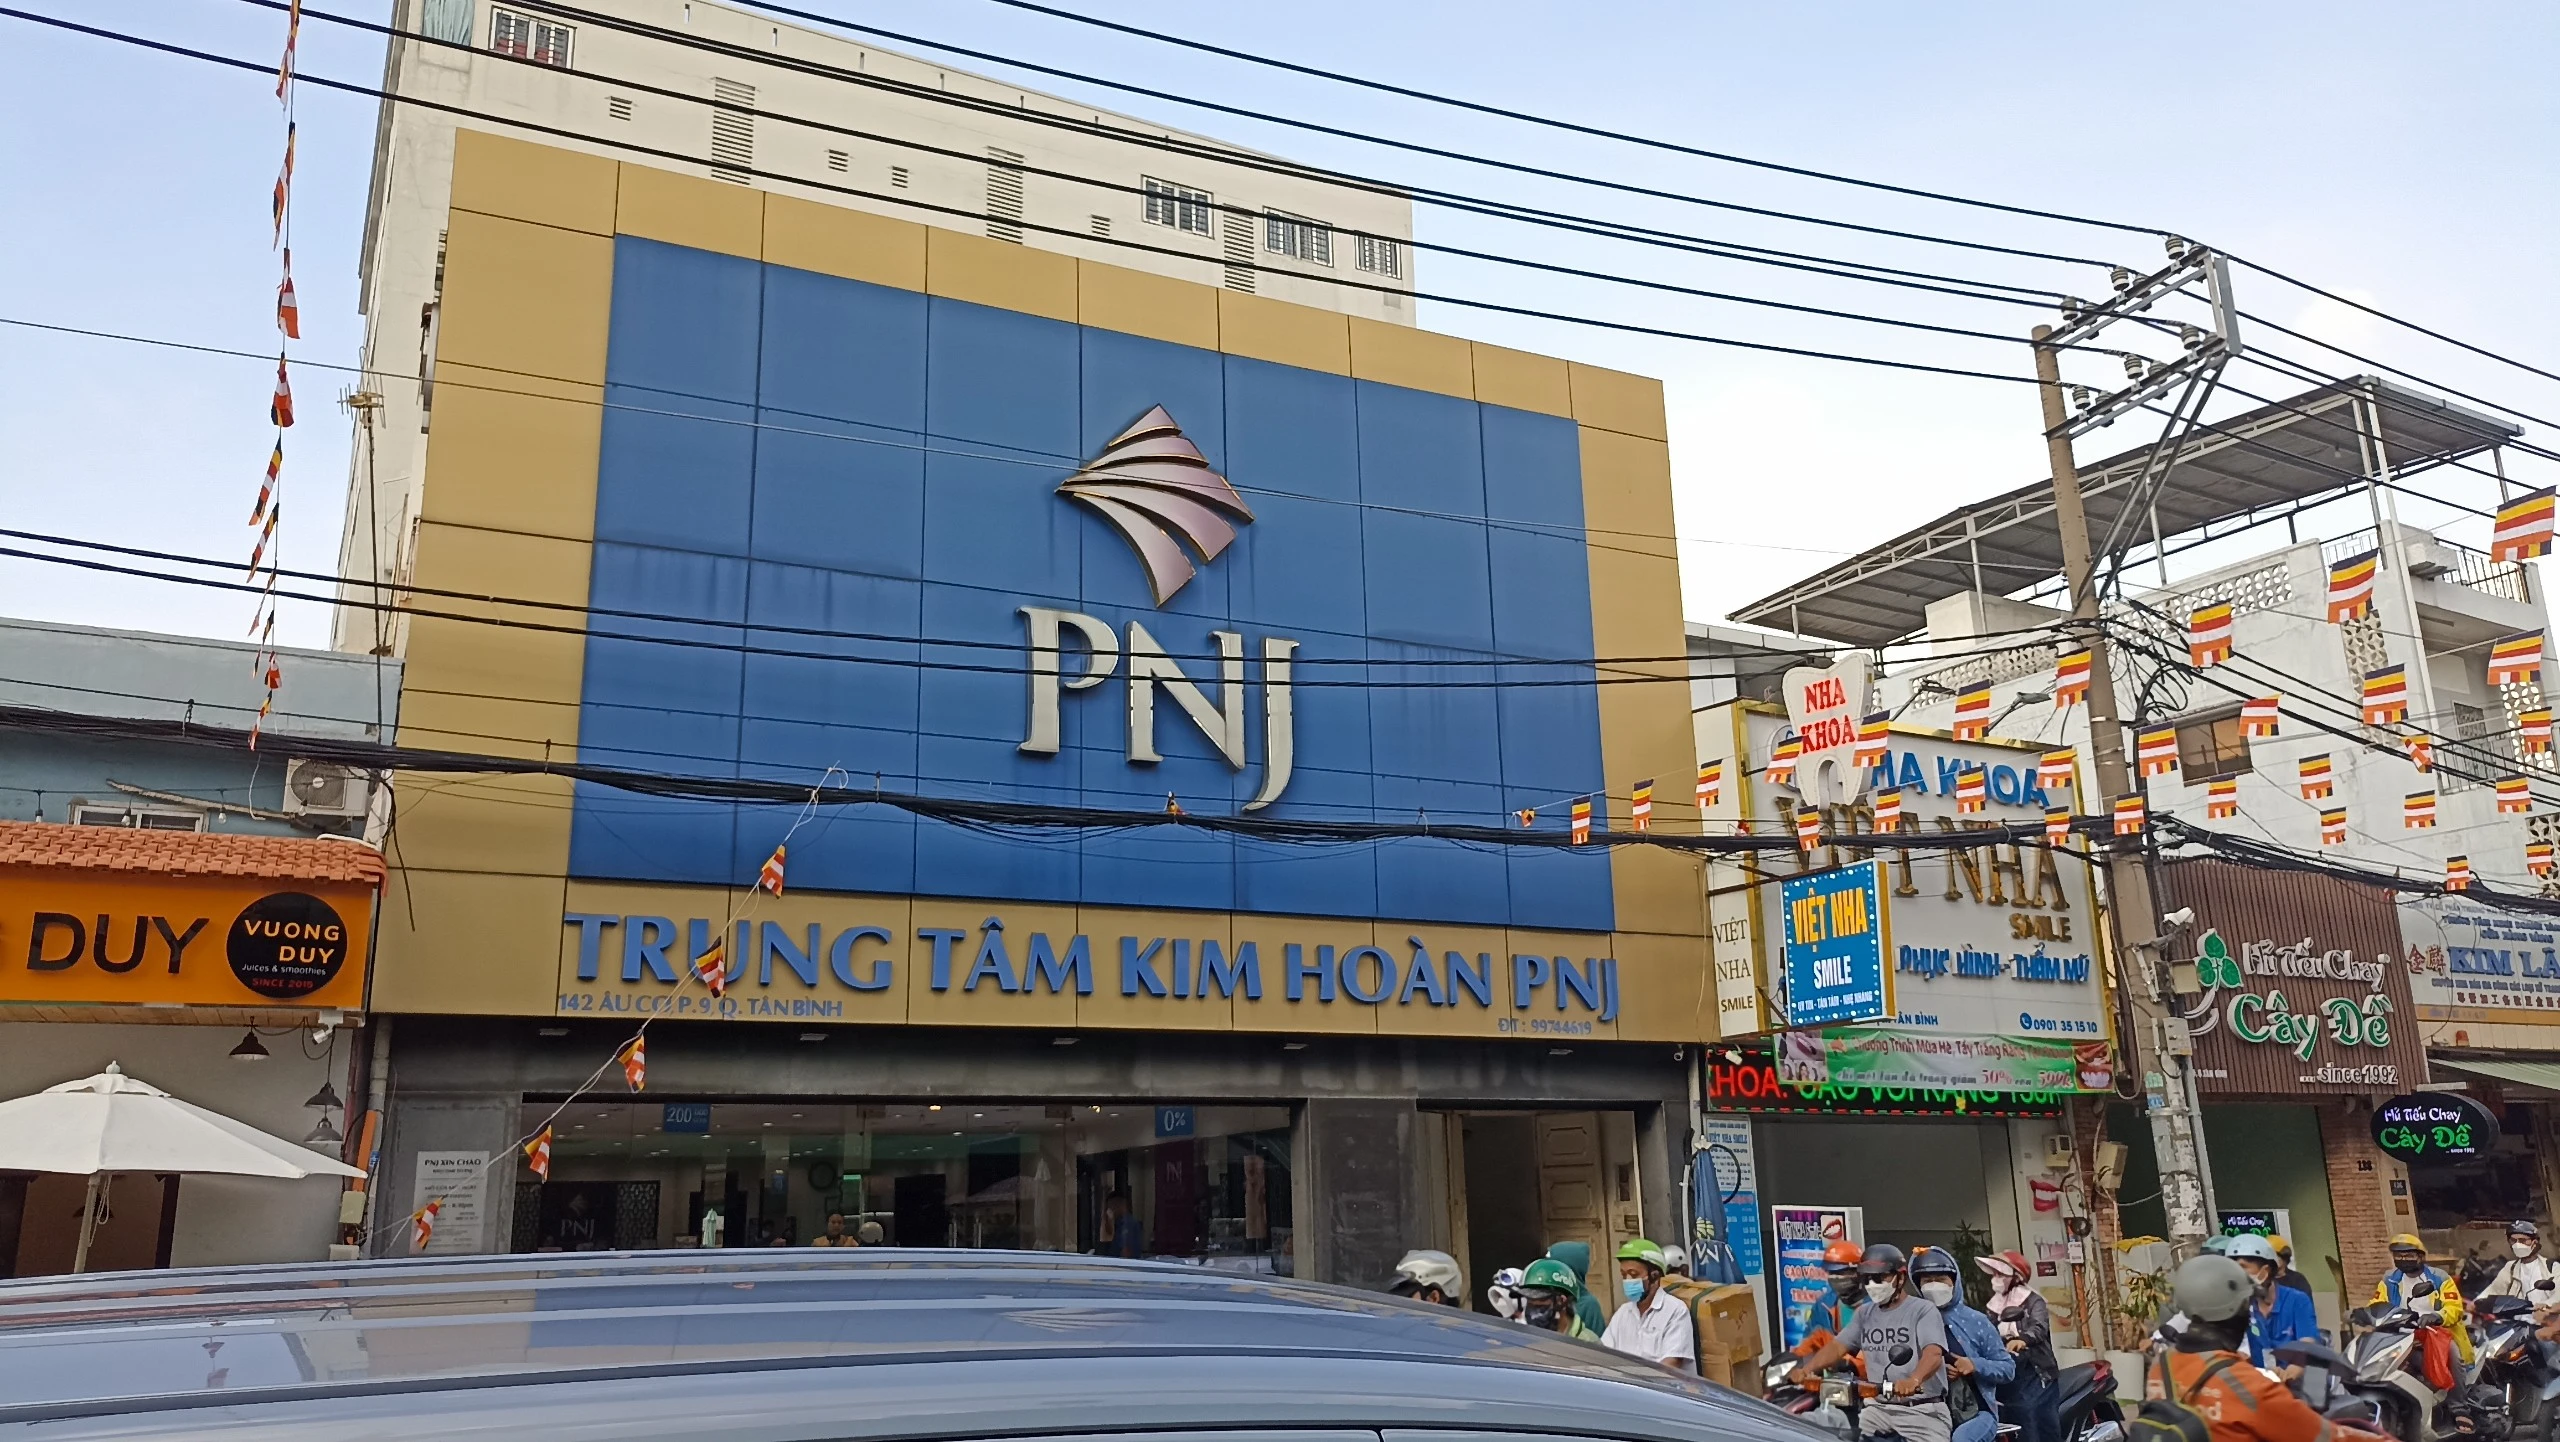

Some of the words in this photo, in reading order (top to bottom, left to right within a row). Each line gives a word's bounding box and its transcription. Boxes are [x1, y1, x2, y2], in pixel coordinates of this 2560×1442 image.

[1016, 605, 1300, 812] PNJ
[1804, 677, 1847, 714] NHA
[1799, 714, 1857, 755] KHOA
[244, 918, 340, 942] VUONG
[1713, 916, 1748, 945] VIỆT
[1791, 887, 1826, 953] VIỆT
[1830, 886, 1868, 938] NHA
[2009, 913, 2072, 943] SMILE
[27, 911, 210, 974] DUY
[279, 945, 334, 964] DUY
[563, 911, 894, 992] TRUNG
[917, 916, 1095, 996] TÂM
[1119, 935, 1263, 999] KIM
[1284, 934, 1493, 1008] HOÀN
[1512, 953, 1620, 1022] PNJ
[1716, 957, 1752, 983] NHA
[1813, 955, 1853, 989] SMILE
[2322, 949, 2388, 992] Chay
[2447, 946, 2515, 977] KIM
[558, 993, 593, 1011] 142
[598, 990, 631, 1012] ÂU
[1720, 995, 1754, 1013] SMILE
[1530, 1019, 1593, 1035] 99744619
[1914, 1010, 1939, 1025] BÌNH
[2033, 1019, 2057, 1031] 0901
[2061, 1020, 2073, 1032] 35
[2076, 1020, 2086, 1032] 15
[2087, 1021, 2097, 1033] 10
[2226, 989, 2320, 1062] Cây
[2320, 993, 2394, 1047] Đề
[1982, 1069, 2013, 1085] 50%
[2361, 1064, 2399, 1085] 1992
[666, 1106, 692, 1122] 200
[1164, 1110, 1186, 1132] 0%
[2403, 1105, 2426, 1122] Tiếu
[2428, 1107, 2461, 1124] Chay
[2380, 1125, 2426, 1154] Cây
[2431, 1123, 2473, 1148] Đề
[1862, 1326, 1910, 1344] KORS
